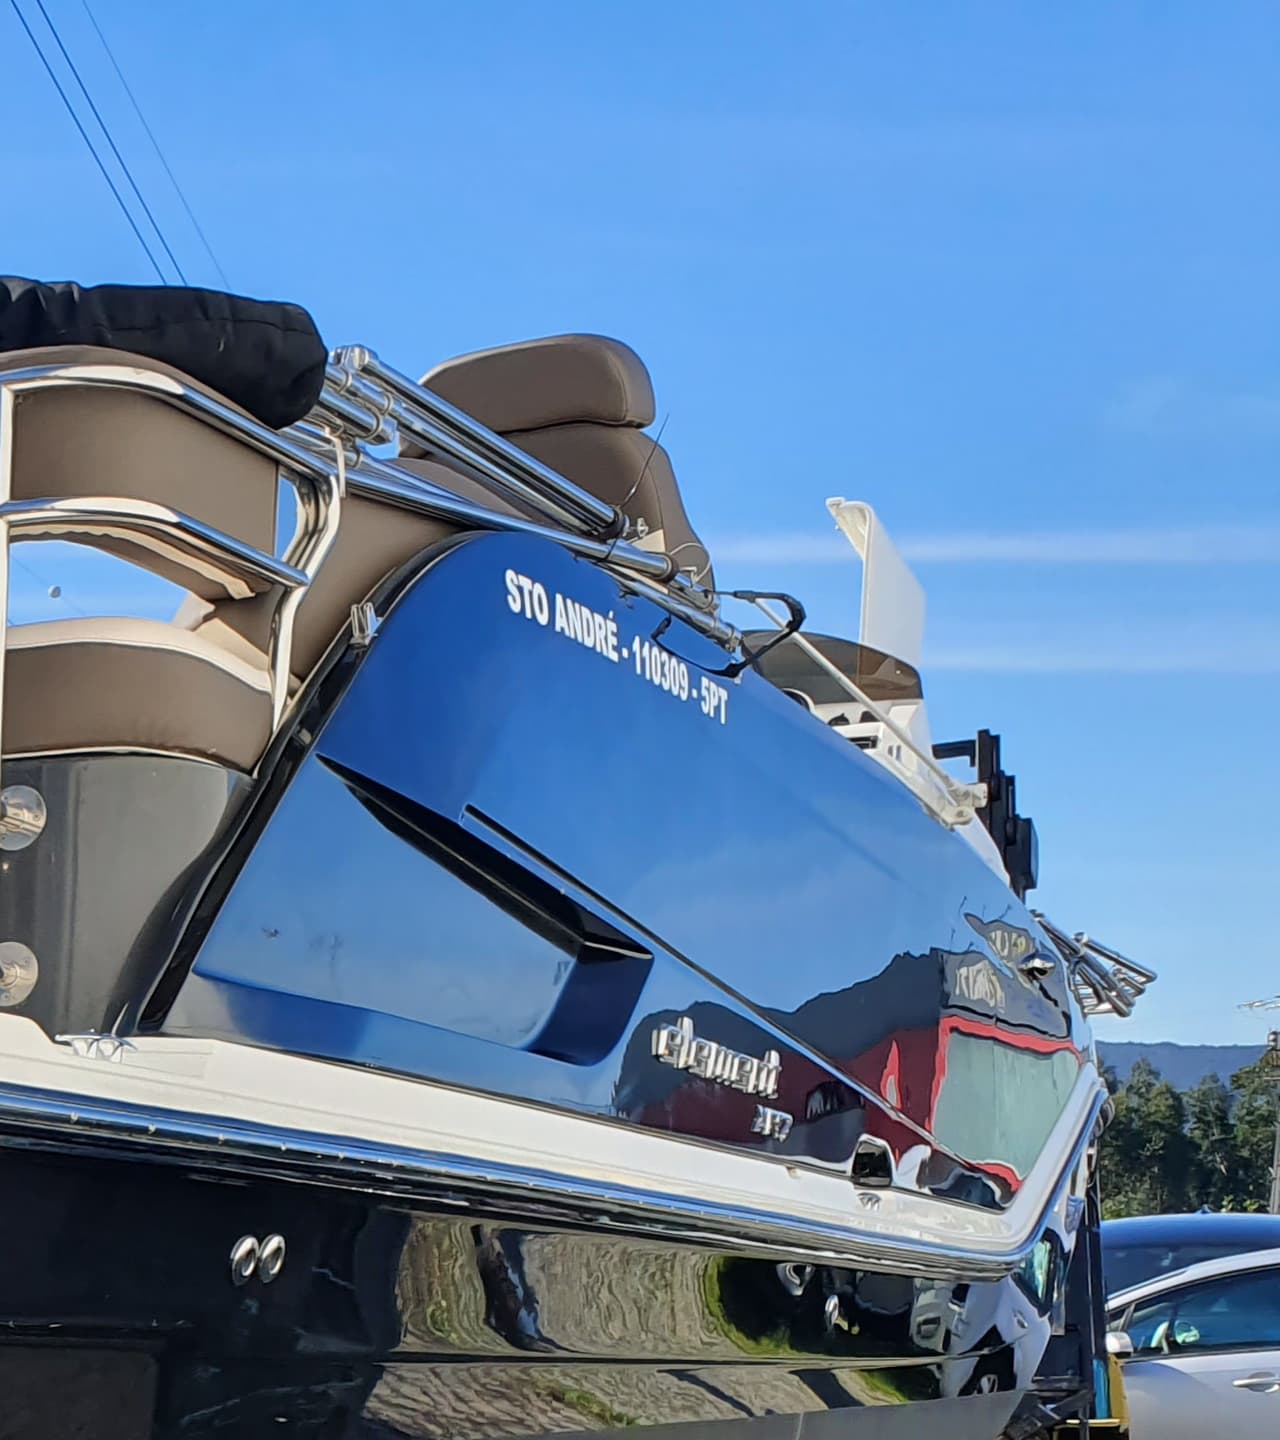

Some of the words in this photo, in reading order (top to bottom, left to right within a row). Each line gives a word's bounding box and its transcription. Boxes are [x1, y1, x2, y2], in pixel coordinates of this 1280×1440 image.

[505, 568, 549, 626] STO
[555, 593, 619, 663] ANDRÉ
[633, 635, 689, 701] 110309
[700, 676, 728, 725] 5PT
